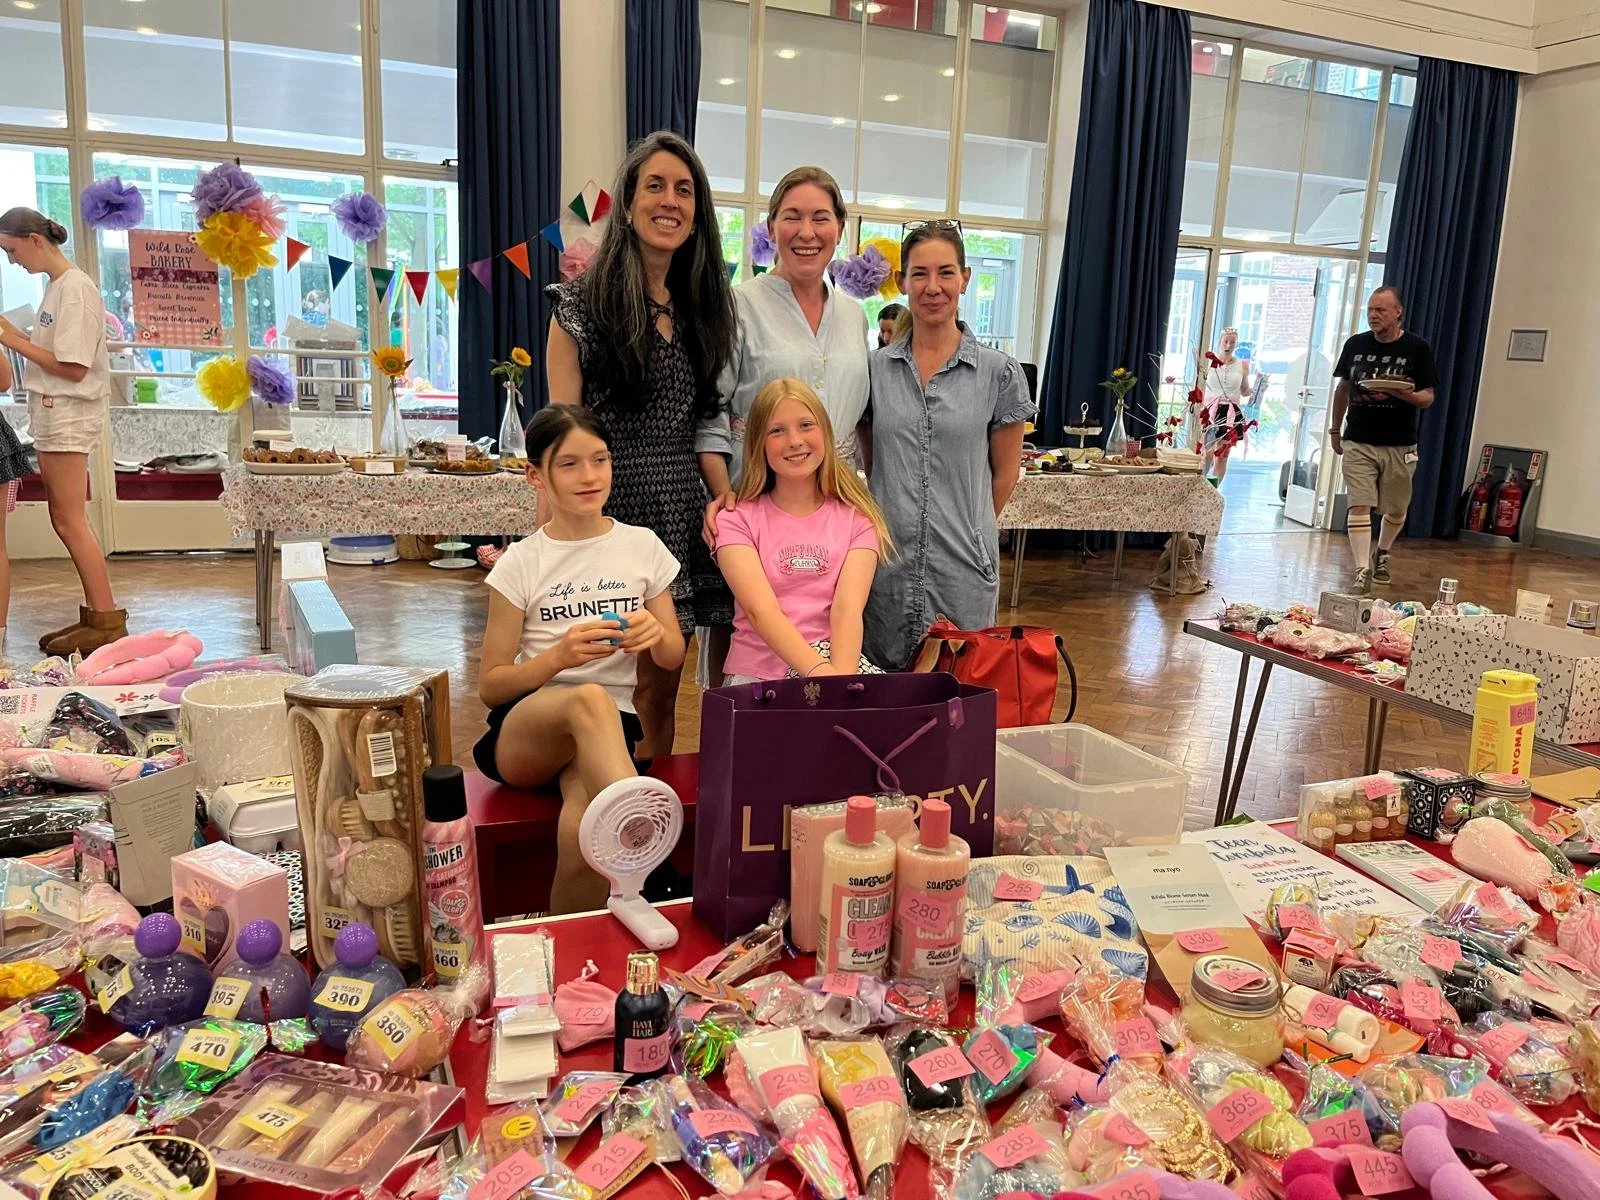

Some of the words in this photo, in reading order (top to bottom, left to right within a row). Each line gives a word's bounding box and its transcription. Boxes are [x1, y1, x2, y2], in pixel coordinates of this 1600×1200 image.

[145, 241, 171, 254] Wild
[175, 243, 196, 255] Rose
[150, 254, 192, 269] BAKERY
[1353, 354, 1407, 365] RUSH
[549, 582, 575, 600] Life
[580, 582, 591, 593] is
[597, 578, 627, 591] better
[540, 596, 639, 621] BRUNETTE
[1511, 727, 1523, 775] BYOMA
[1207, 838, 1259, 851] Teen
[1210, 843, 1296, 863] Tombola
[1005, 881, 1033, 894] 255
[908, 898, 940, 922] 280
[184, 924, 202, 942] 310
[324, 916, 349, 931] 325
[1184, 932, 1214, 946] 330
[433, 952, 459, 968] 460
[327, 990, 361, 1007] 390
[1312, 996, 1335, 1021] 420
[575, 1006, 603, 1017] 170
[376, 1015, 405, 1044] 380
[1116, 1026, 1151, 1048] 305
[1486, 1028, 1516, 1051] 410
[189, 1041, 227, 1058] 470
[637, 1042, 667, 1062] 180
[977, 1042, 1006, 1071] 270
[923, 1052, 958, 1073] 260
[568, 1086, 602, 1109] 210
[853, 1079, 890, 1098] 240
[1220, 1091, 1259, 1124] 365
[255, 1111, 290, 1129] 475
[704, 1111, 741, 1125] 220
[996, 1132, 1035, 1158] 285
[225, 1155, 309, 1181] CHAMPNEYS
[591, 1145, 627, 1175] 215
[1363, 1156, 1399, 1177] 445
[125, 1163, 146, 1181] BODY
[484, 1160, 524, 1194] 205
